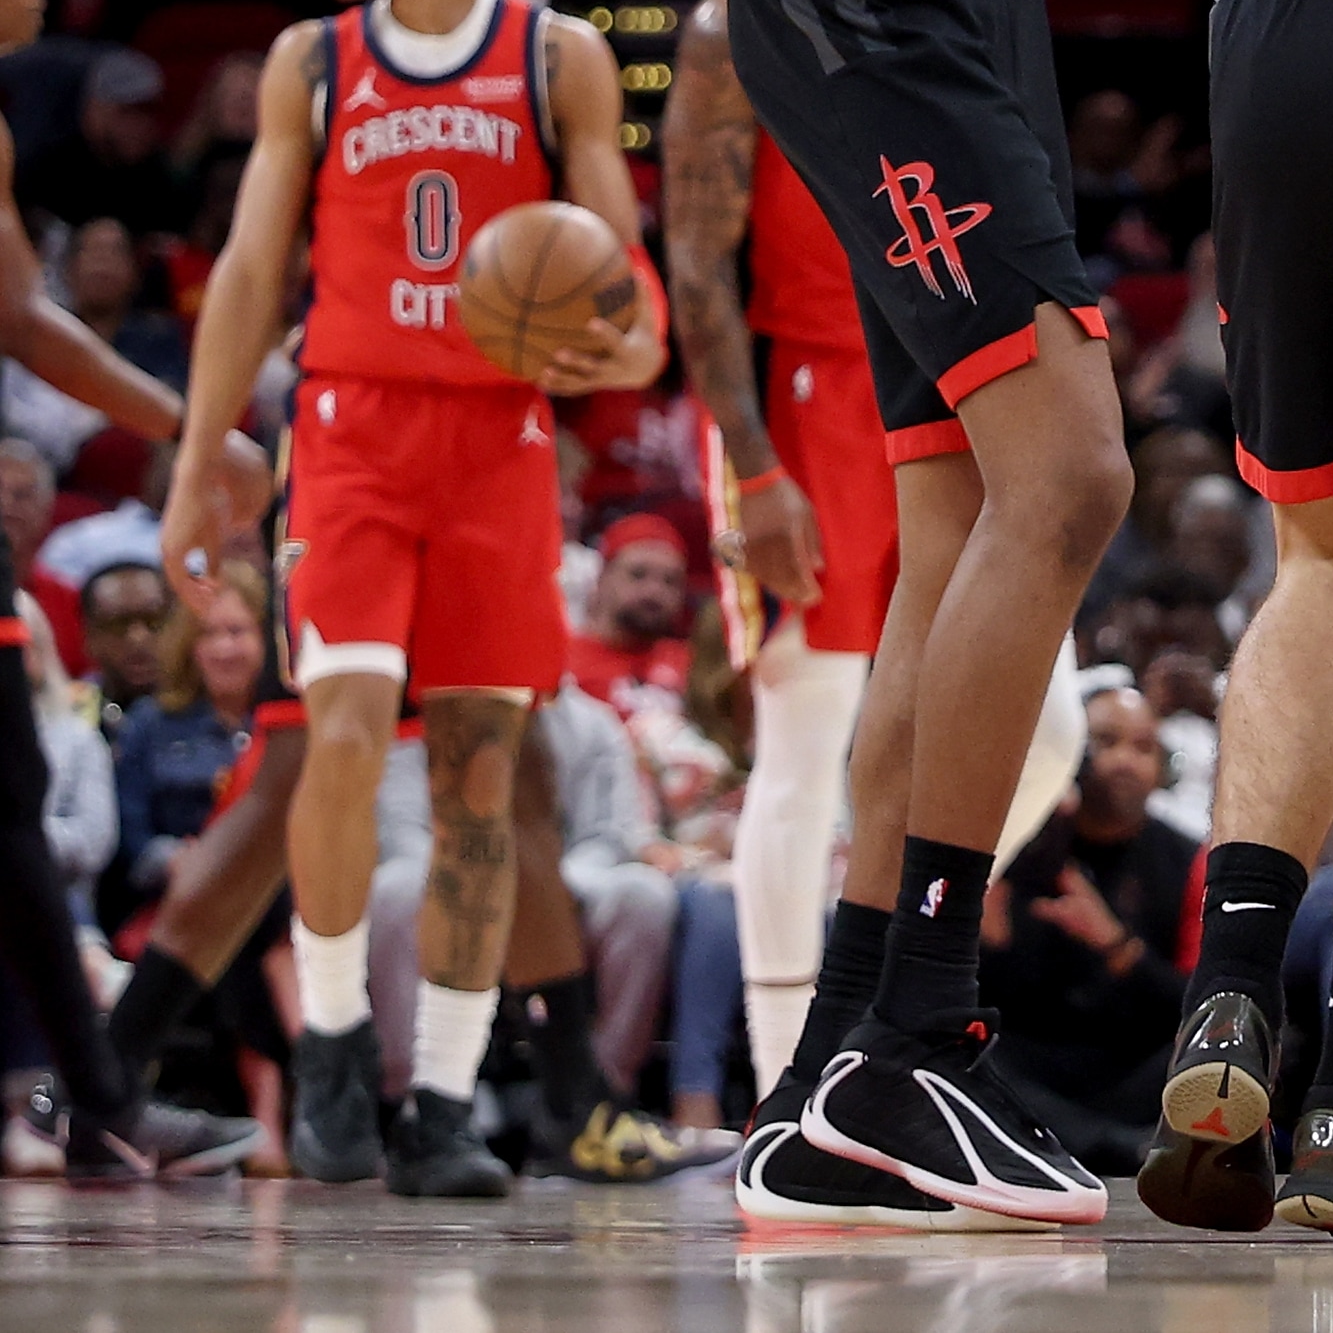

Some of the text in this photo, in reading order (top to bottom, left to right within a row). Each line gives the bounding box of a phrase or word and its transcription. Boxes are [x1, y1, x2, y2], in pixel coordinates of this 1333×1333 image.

[342, 104, 523, 176] CRESCENT
[403, 168, 463, 272] 0
[389, 277, 461, 331] CIT
